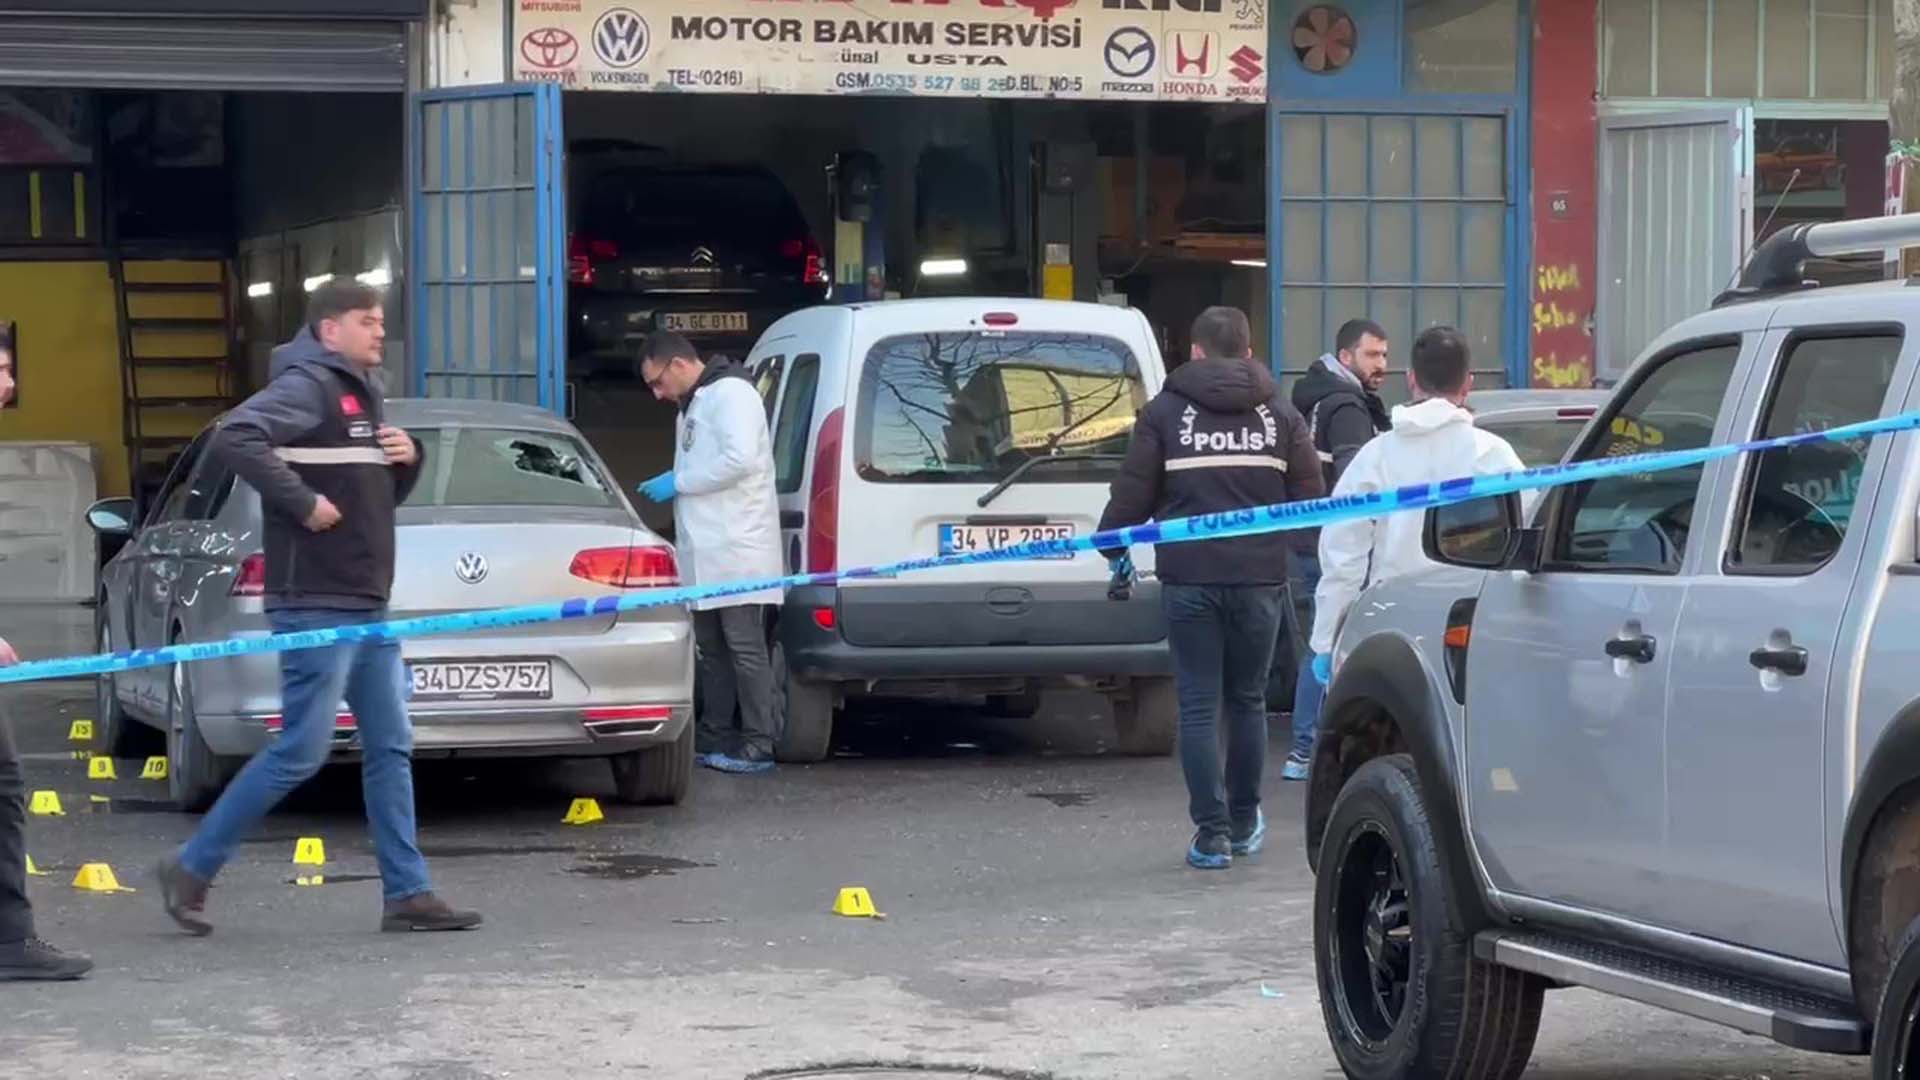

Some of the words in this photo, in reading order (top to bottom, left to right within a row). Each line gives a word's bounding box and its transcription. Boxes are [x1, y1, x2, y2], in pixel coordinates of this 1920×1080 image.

[671, 16, 803, 42] MOTOR
[813, 19, 934, 45] BAKIM
[907, 53, 1008, 66] USTA
[924, 74, 954, 92] 527
[1163, 82, 1217, 95] HONDA
[666, 315, 683, 330] 34
[952, 529, 976, 550] 34
[986, 528, 1010, 551] VP
